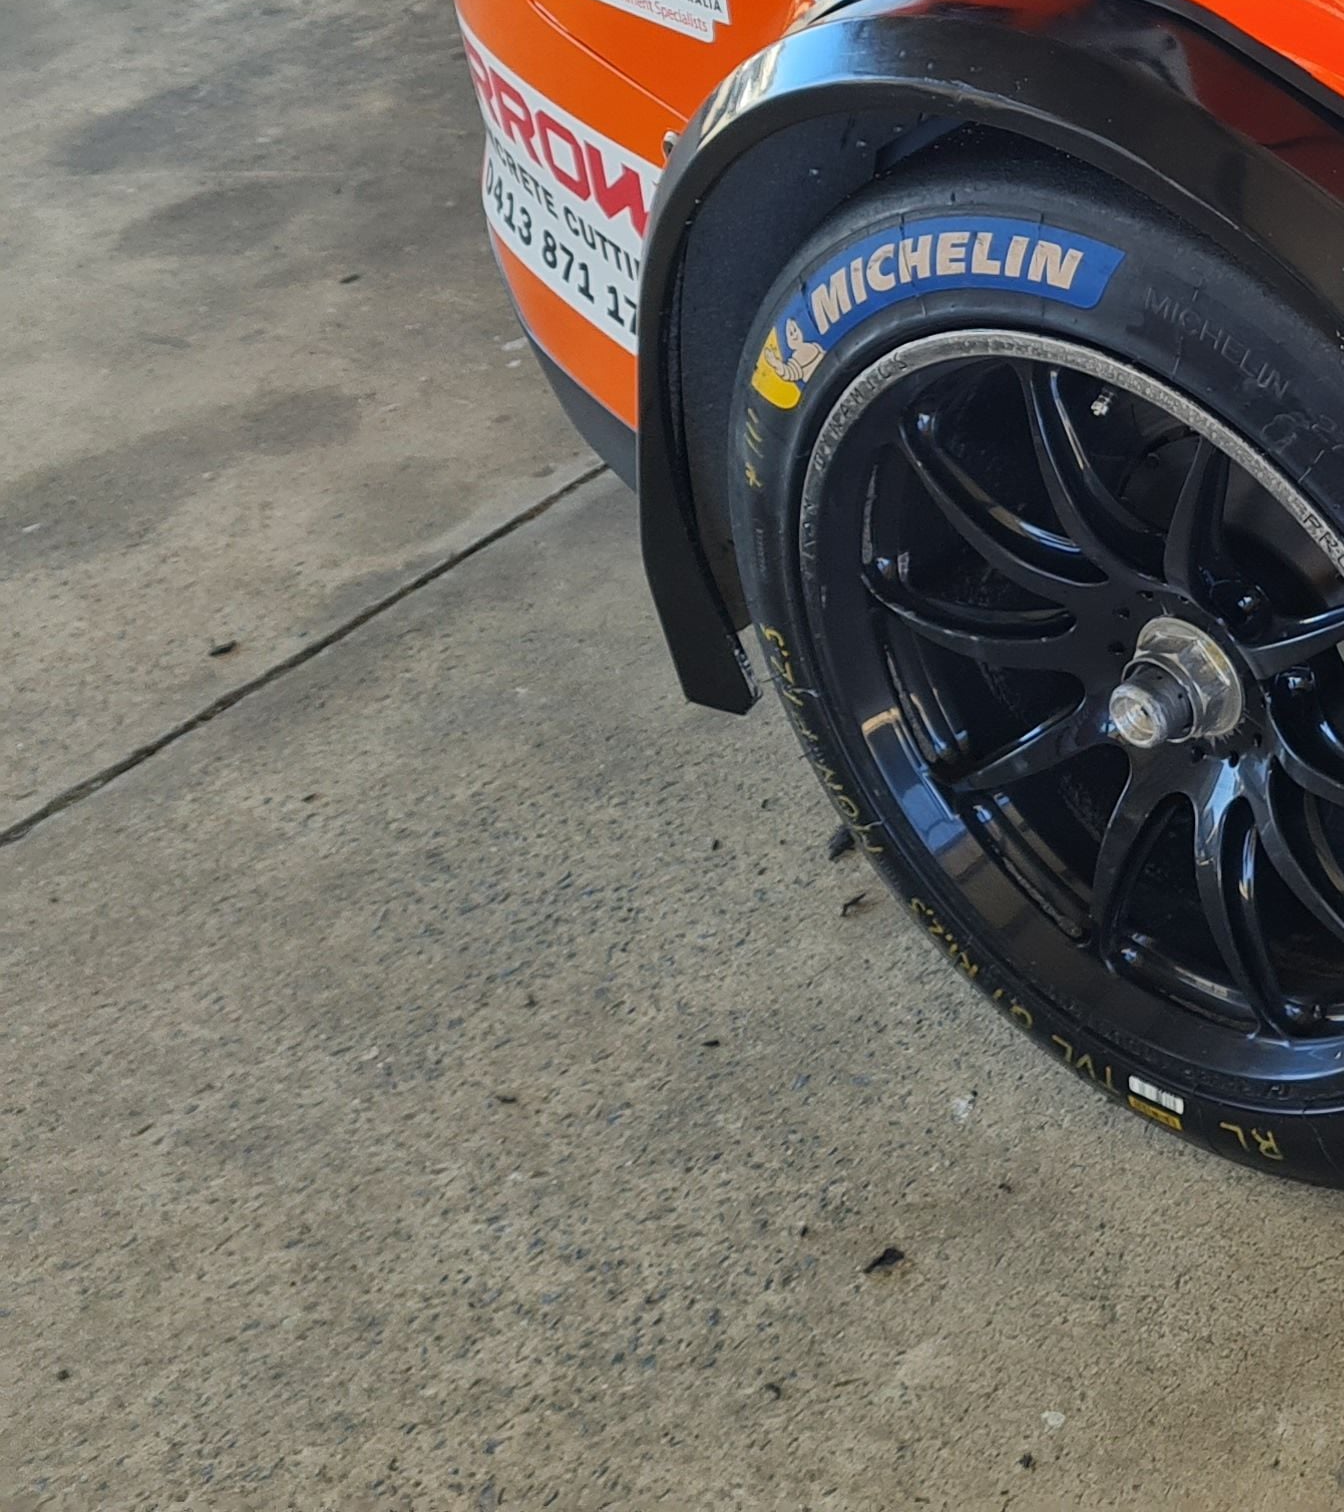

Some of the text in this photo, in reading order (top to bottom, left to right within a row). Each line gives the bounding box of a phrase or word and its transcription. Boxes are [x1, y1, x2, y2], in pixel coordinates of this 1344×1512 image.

[654, 1, 708, 33] Specialists
[491, 140, 560, 220] CRETE
[485, 157, 532, 246] 0413
[541, 231, 596, 305] 871
[809, 231, 1085, 336] MICHELIN
[1144, 287, 1292, 402] MICHELIN
[1219, 1120, 1284, 1161] RL
